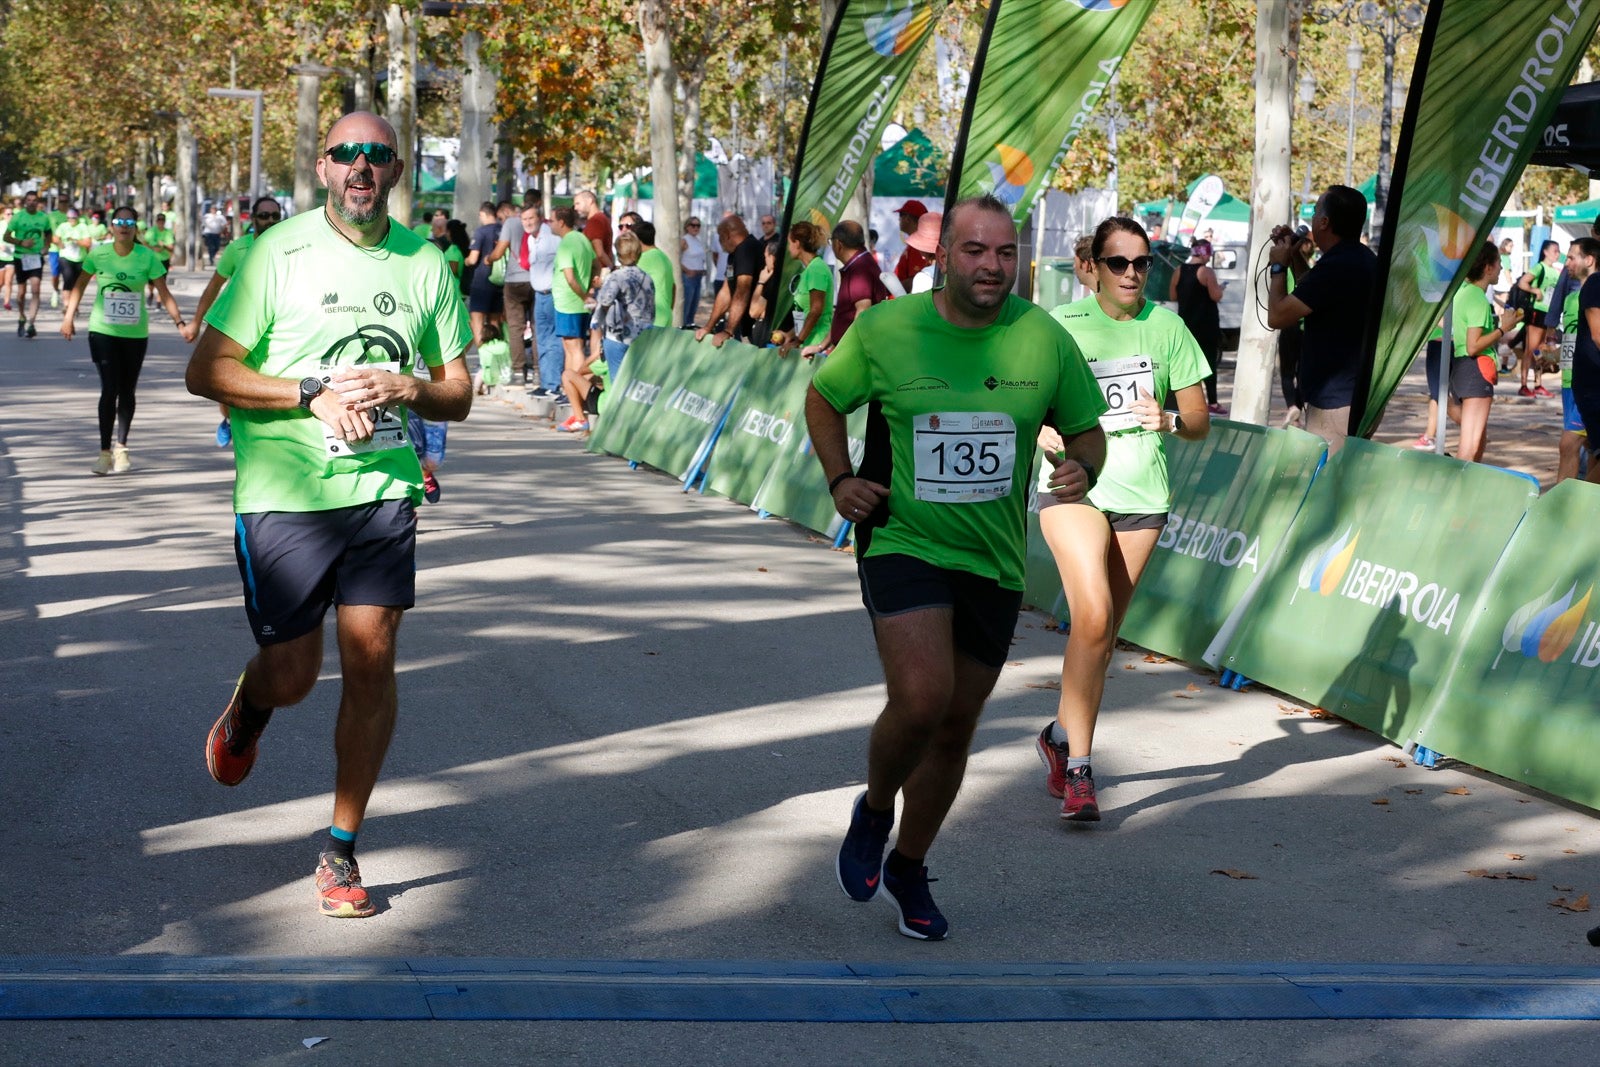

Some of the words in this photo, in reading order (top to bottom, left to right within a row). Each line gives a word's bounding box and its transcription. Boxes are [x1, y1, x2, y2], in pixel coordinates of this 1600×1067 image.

[1459, 0, 1583, 214] IBERDROLA
[111, 302, 135, 316] 153
[325, 305, 367, 314] IBERDROLA
[931, 441, 1000, 476] 135
